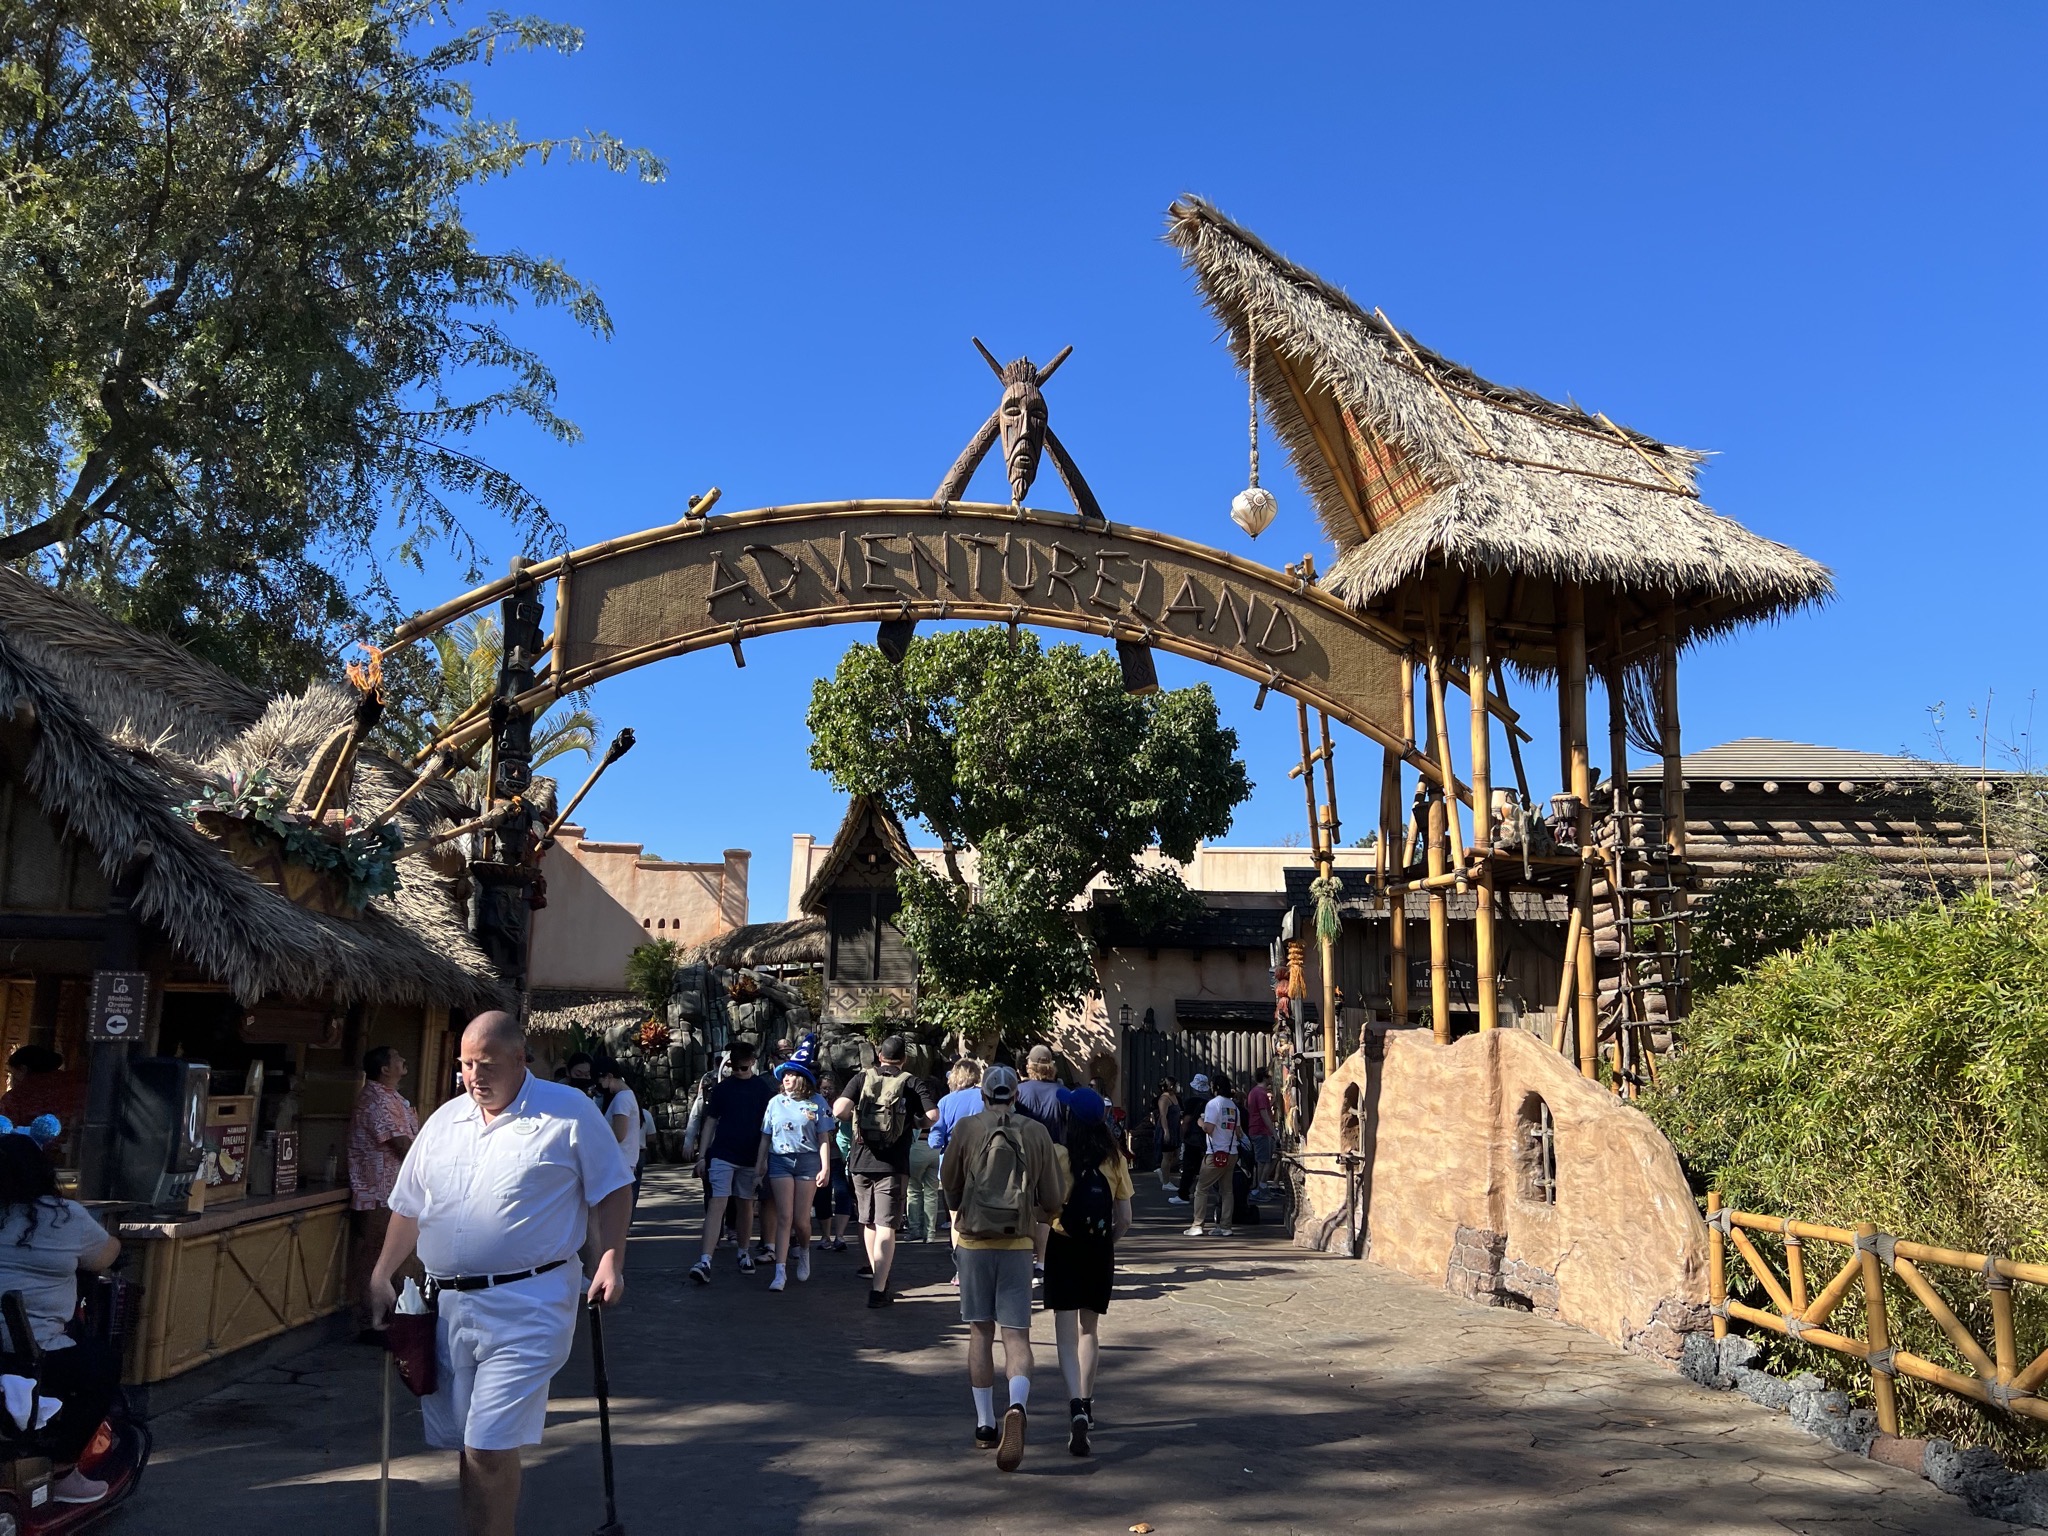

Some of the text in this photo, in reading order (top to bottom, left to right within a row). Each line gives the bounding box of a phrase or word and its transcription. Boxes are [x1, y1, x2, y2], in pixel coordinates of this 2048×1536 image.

[706, 529, 1303, 655] ADVENTURELAND
[1415, 979, 1471, 989] MENTLE
[122, 1007, 133, 1015] Up
[222, 1135, 246, 1146] PINEAPPLE
[231, 1145, 245, 1155] JUICE
